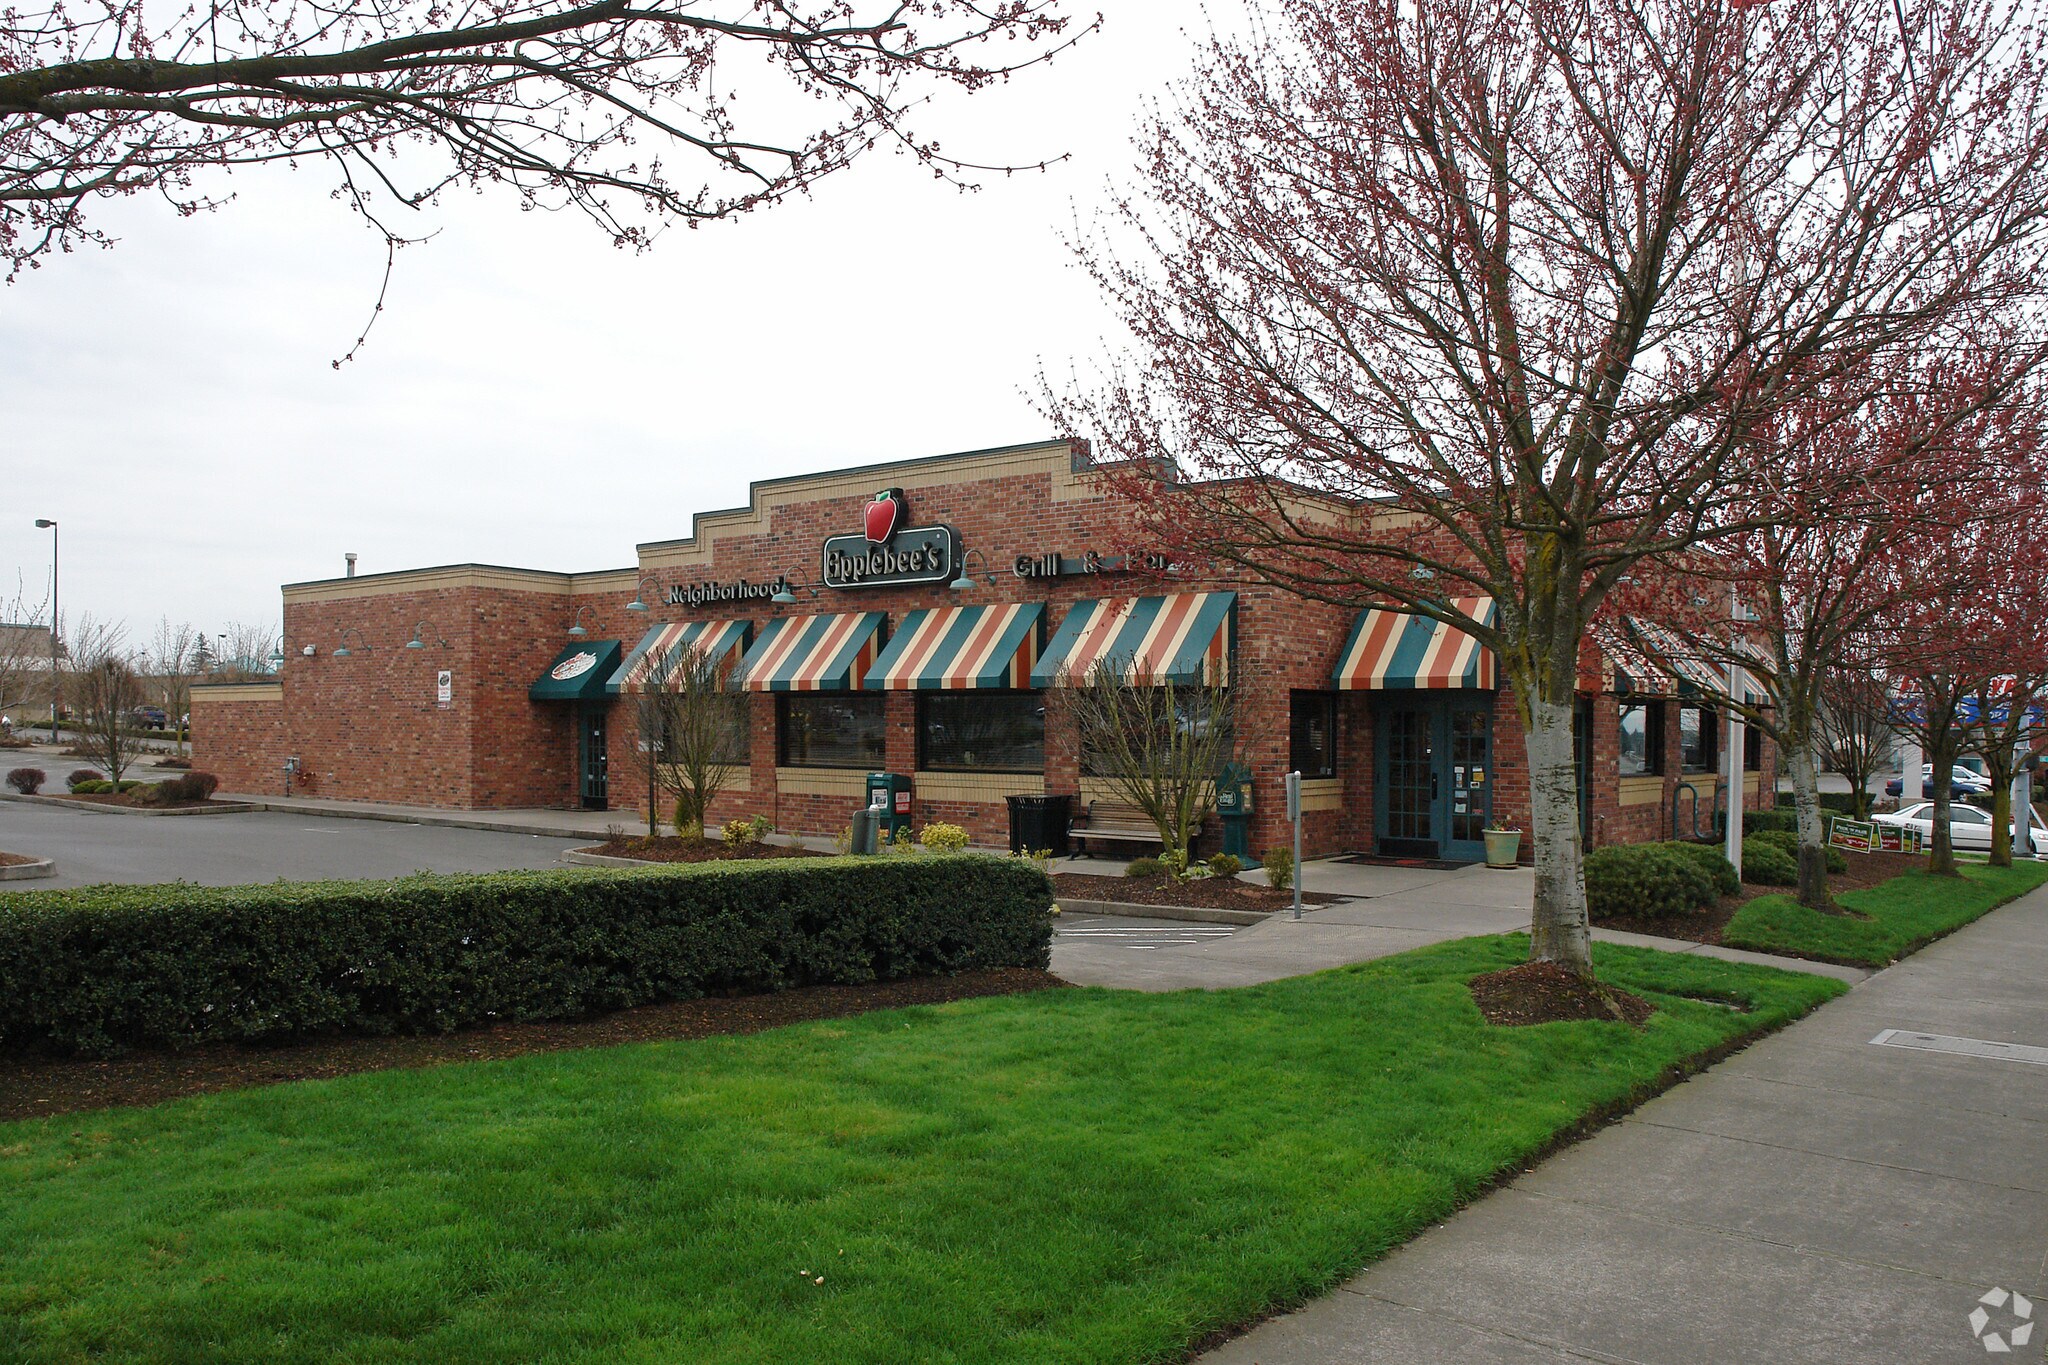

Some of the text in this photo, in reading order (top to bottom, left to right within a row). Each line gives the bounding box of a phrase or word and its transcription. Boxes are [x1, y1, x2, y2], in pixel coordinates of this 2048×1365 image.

[826, 541, 941, 583] Applebee's
[1013, 553, 1059, 578] Grill
[669, 576, 786, 608] Neighborhood
